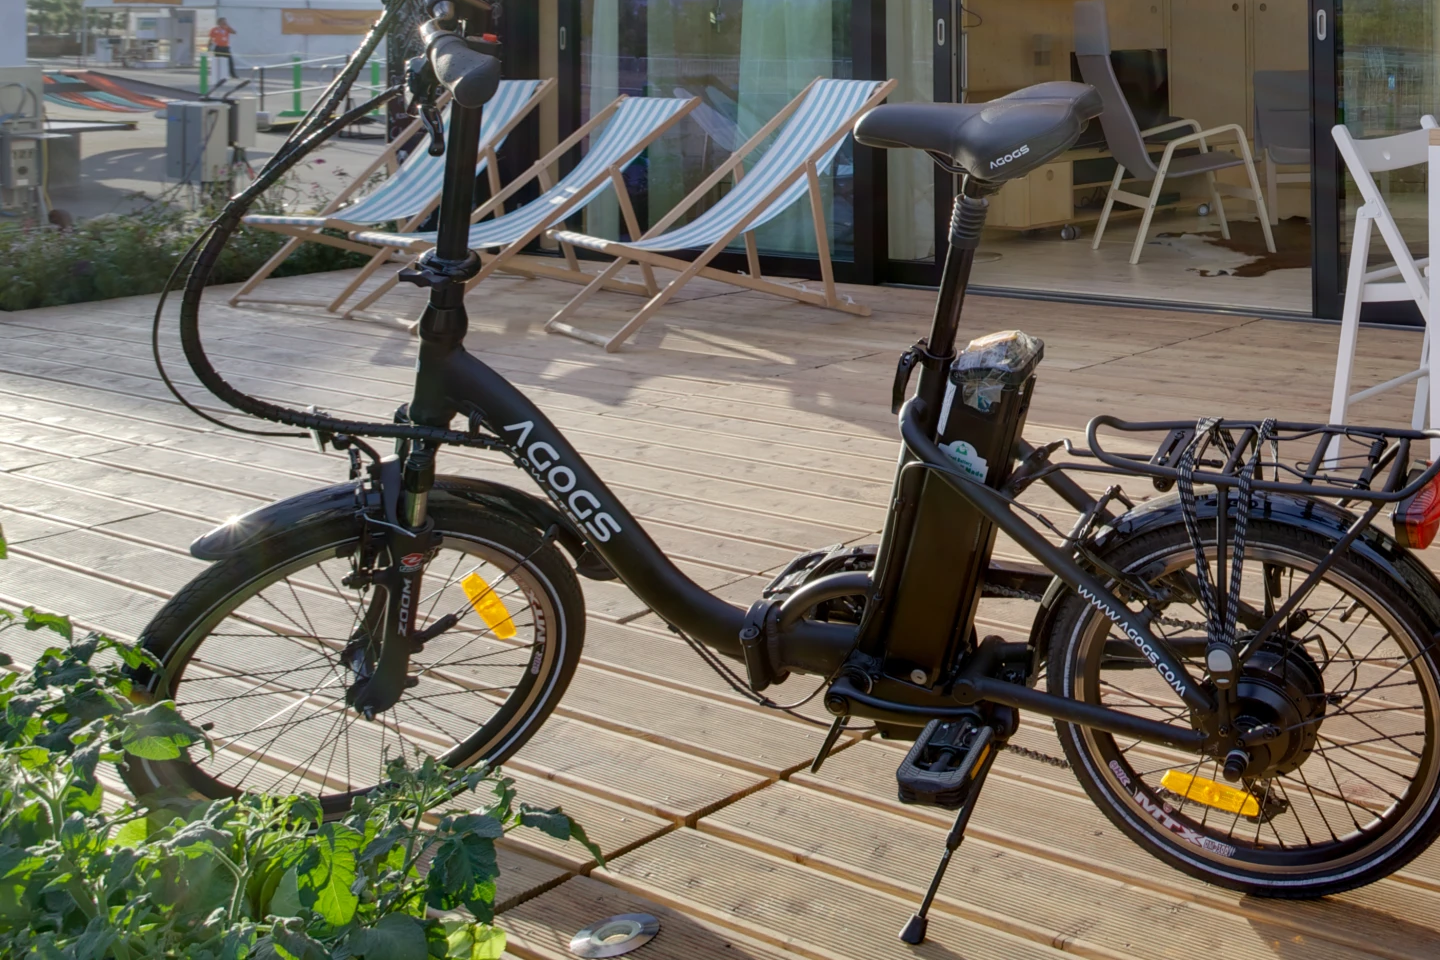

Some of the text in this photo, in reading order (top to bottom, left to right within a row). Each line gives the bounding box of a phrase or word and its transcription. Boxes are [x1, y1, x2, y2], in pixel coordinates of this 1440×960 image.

[989, 144, 1030, 170] AGOGS
[503, 420, 622, 543] AGOGS
[397, 577, 412, 637] ZOOM
[1078, 584, 1186, 697] WWW.AGOGS.COM
